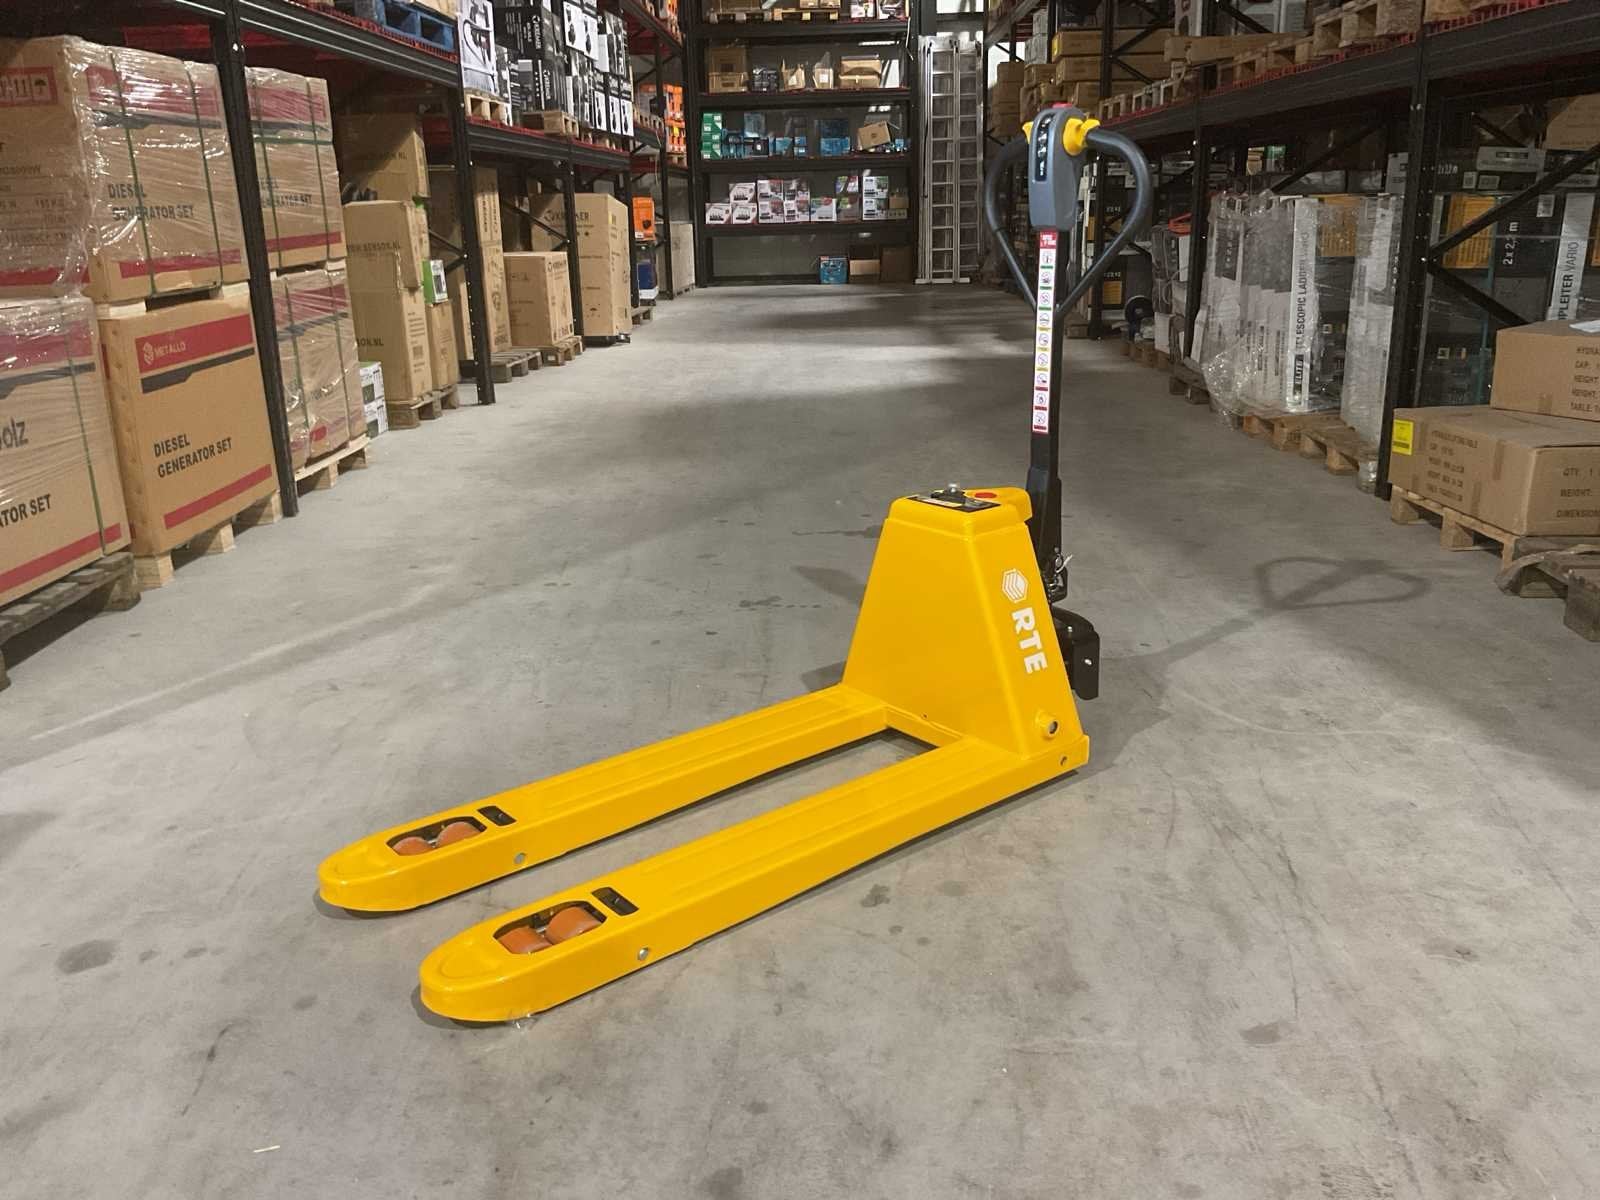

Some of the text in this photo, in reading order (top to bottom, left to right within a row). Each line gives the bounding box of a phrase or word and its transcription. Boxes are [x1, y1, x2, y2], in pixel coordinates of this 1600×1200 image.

[0, 416, 29, 449] olz
[153, 433, 191, 458] DIESEL
[157, 437, 232, 478] GENERATOR SET
[29, 493, 51, 516] SET
[1012, 607, 1048, 673] RTE
